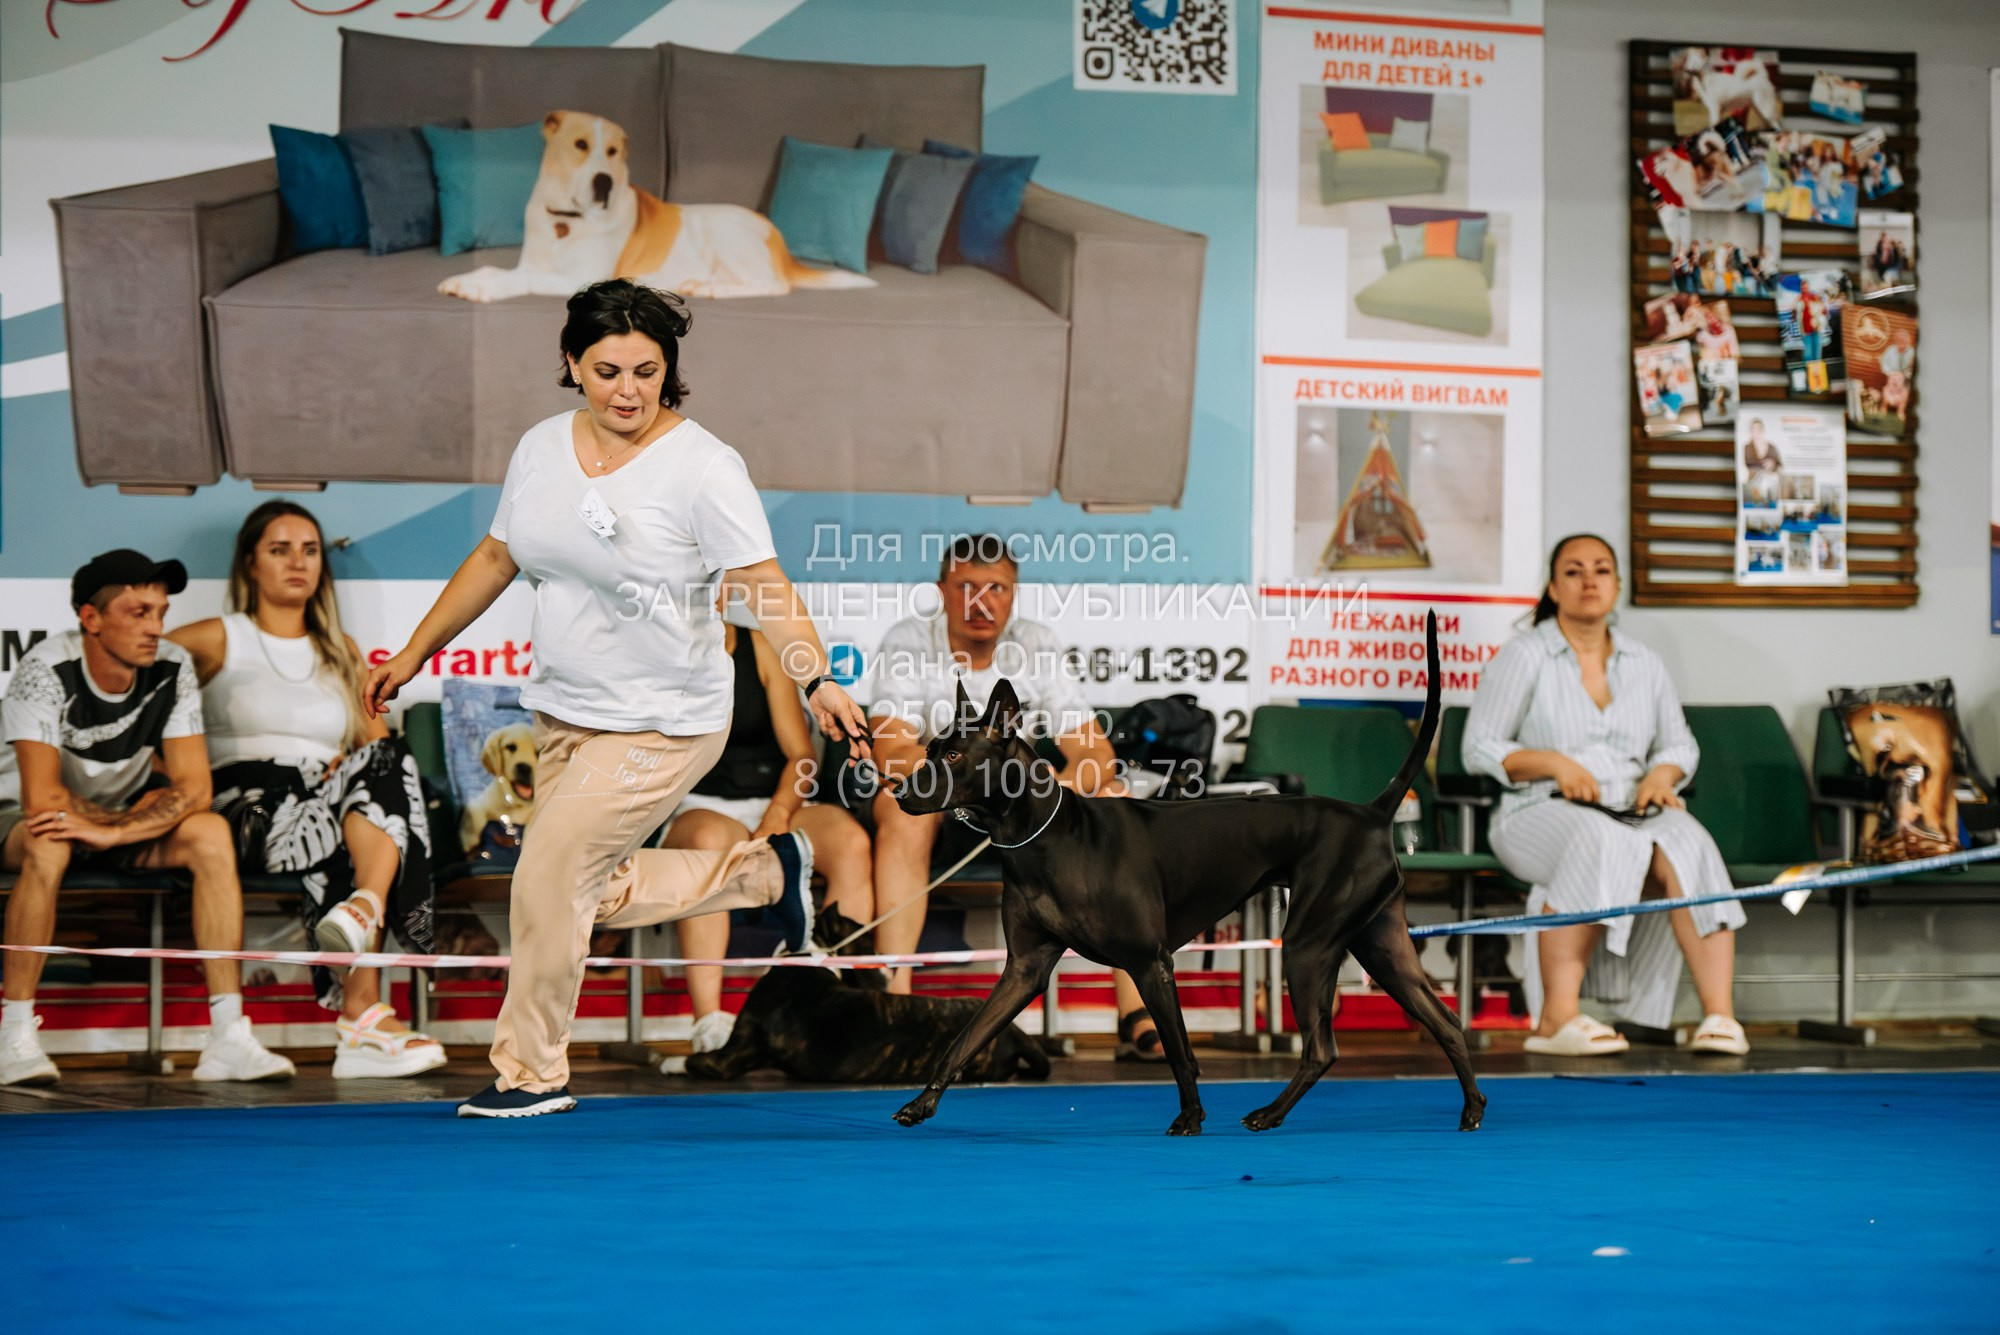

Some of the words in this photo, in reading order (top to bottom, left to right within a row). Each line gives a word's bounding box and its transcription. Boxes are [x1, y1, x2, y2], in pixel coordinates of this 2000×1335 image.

[1314, 30, 1385, 52] МИНИ
[1390, 36, 1496, 62] ДИВАНЫ
[1322, 60, 1371, 82] ДЛЯ
[1377, 63, 1452, 87] ДЕТЕЙ
[1459, 70, 1485, 88] 1+
[1295, 378, 1405, 402] ДЕТСКИЙ
[1412, 387, 1509, 407] ВИГВАМ
[1287, 638, 1340, 661] ДЛЯ
[1348, 641, 1500, 663] ЖИВОНЫХ
[1270, 666, 1390, 689] РАЗНОГО
